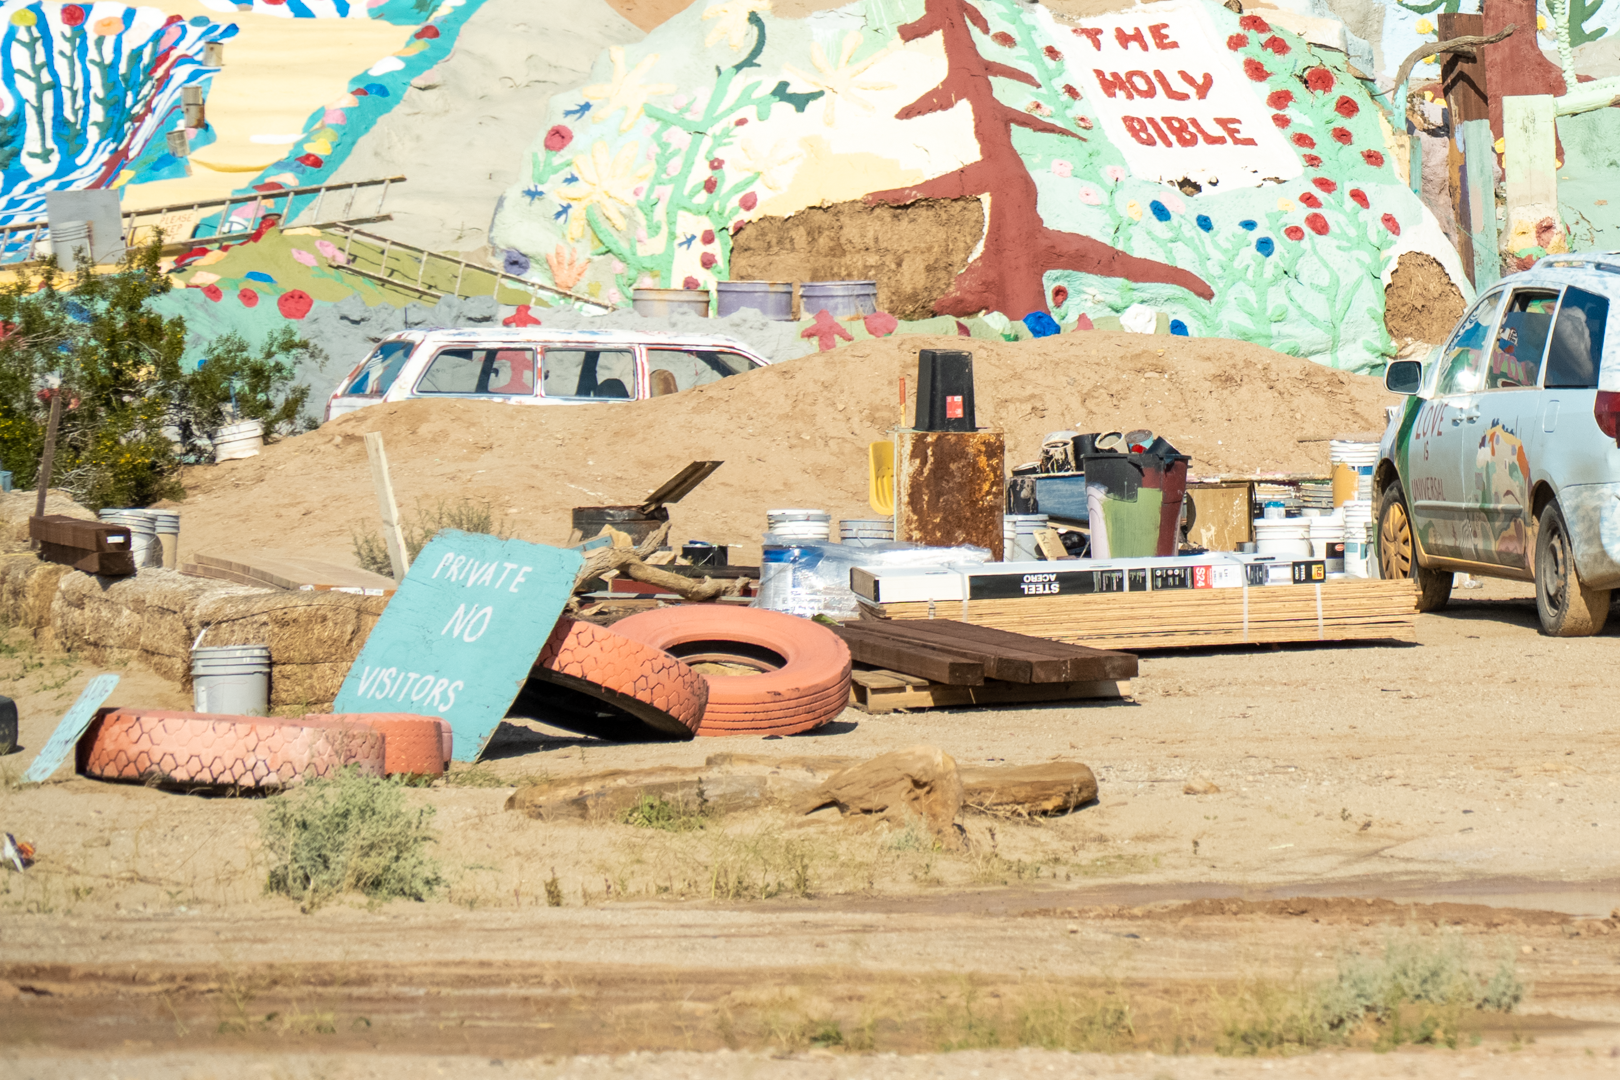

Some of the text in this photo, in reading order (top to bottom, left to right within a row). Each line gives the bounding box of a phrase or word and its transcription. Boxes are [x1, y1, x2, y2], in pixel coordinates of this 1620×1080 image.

[1072, 22, 1179, 52] THE
[1095, 69, 1213, 102] HOLY
[1122, 115, 1257, 148] BIBLE
[1415, 403, 1449, 440] LOVE
[1423, 440, 1429, 461] IS
[1411, 477, 1446, 501] UNIVERSAL
[431, 552, 533, 593] PRIVATE
[1023, 573, 1057, 583] ACERO
[1196, 567, 1206, 587] S24
[1021, 584, 1060, 595] STEEL
[441, 603, 493, 642] NO
[357, 665, 464, 712] VISITORS
